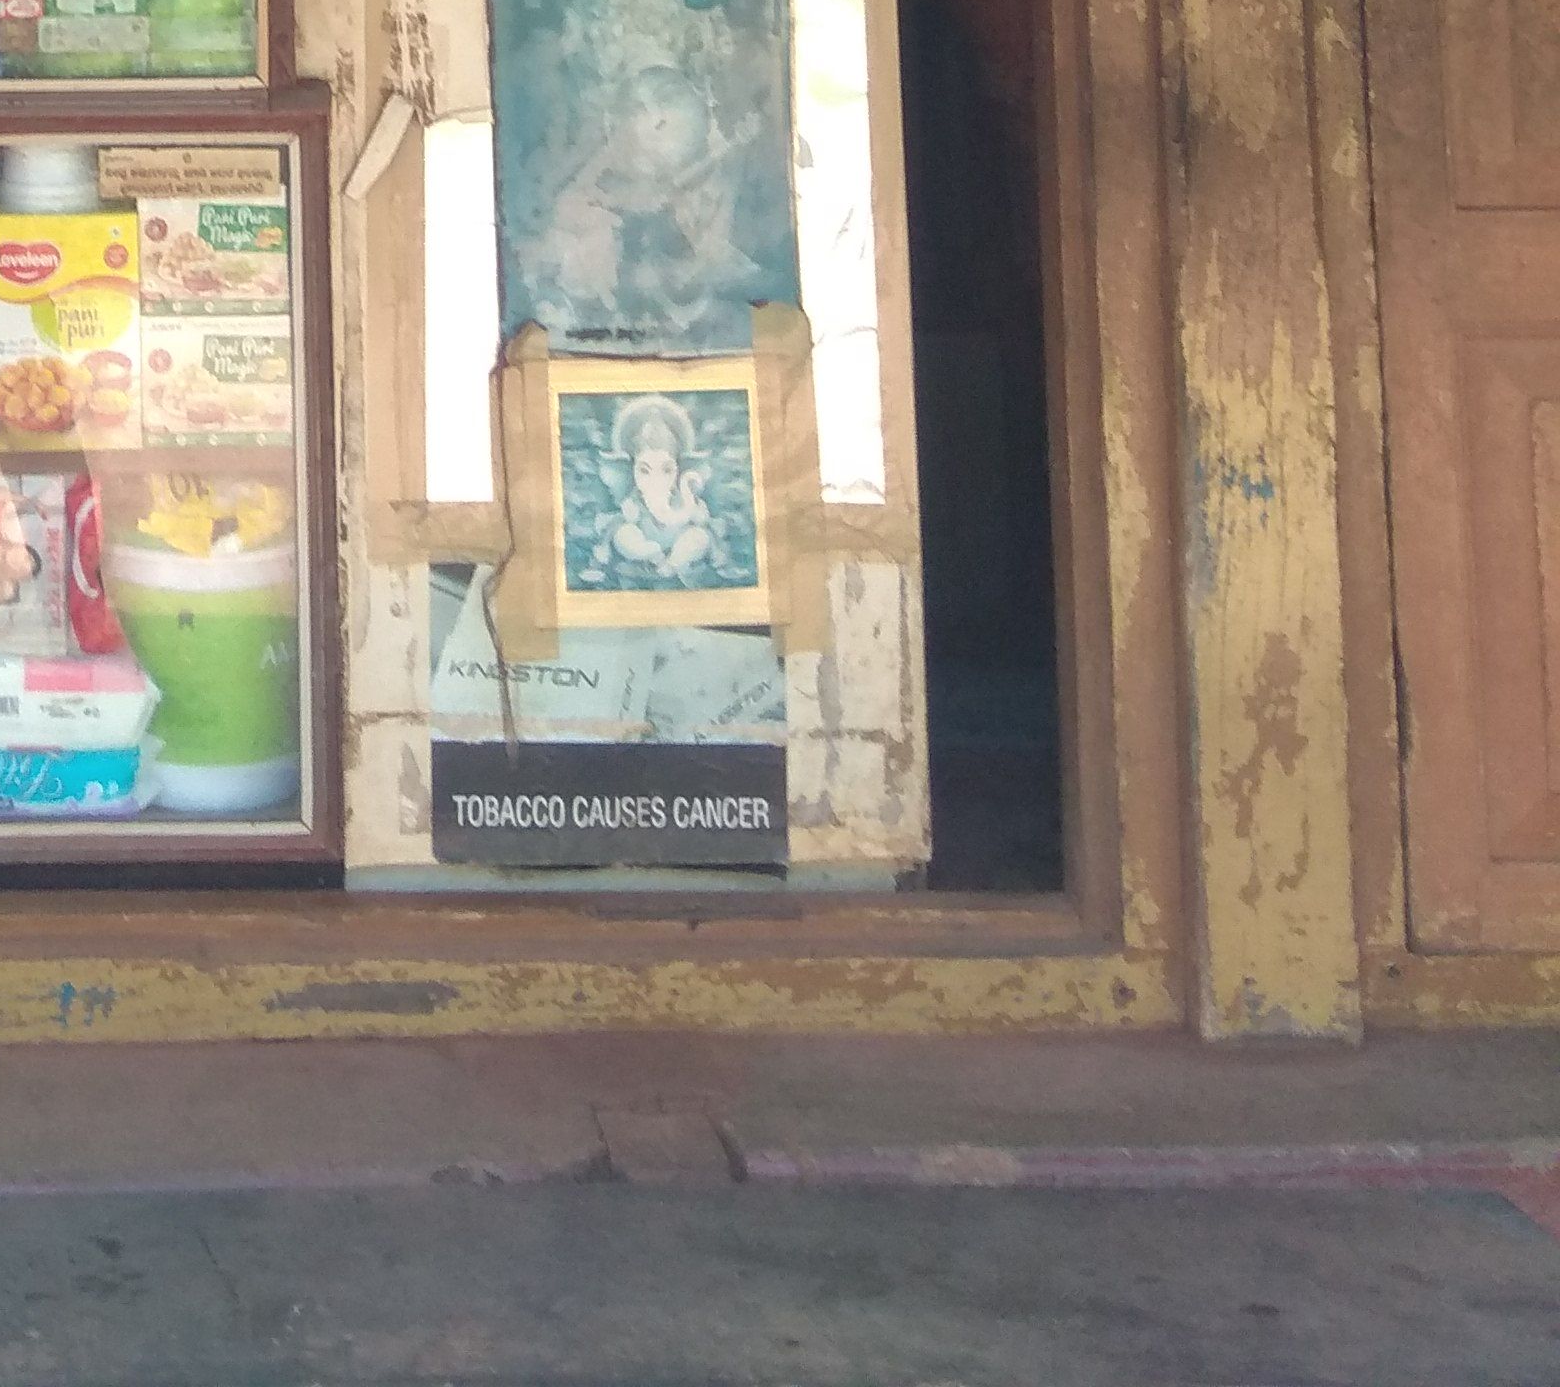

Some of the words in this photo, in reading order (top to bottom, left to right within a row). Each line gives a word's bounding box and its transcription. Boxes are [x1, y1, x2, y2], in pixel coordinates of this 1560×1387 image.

[57, 307, 99, 332] pani
[451, 794, 566, 829] TOBACCO
[572, 795, 667, 830] CAUSES
[673, 795, 771, 831] CANCER
